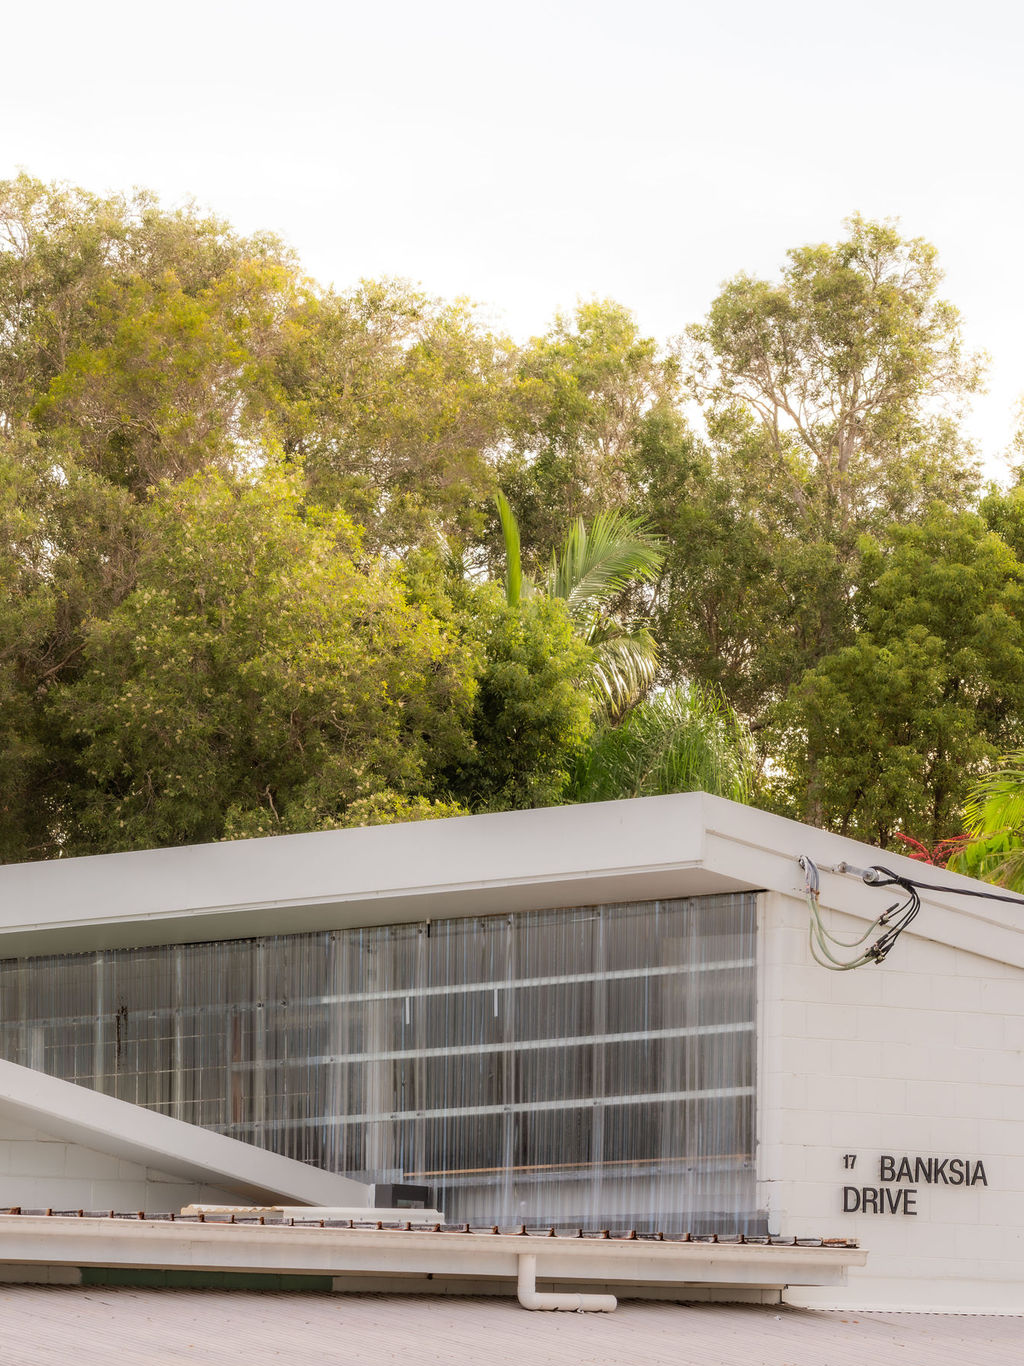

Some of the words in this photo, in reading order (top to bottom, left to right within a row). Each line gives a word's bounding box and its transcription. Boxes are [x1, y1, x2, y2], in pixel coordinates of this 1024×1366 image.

[842, 1154, 857, 1169] 17
[880, 1155, 988, 1187] BANKSIA
[843, 1186, 918, 1216] DRIVE
